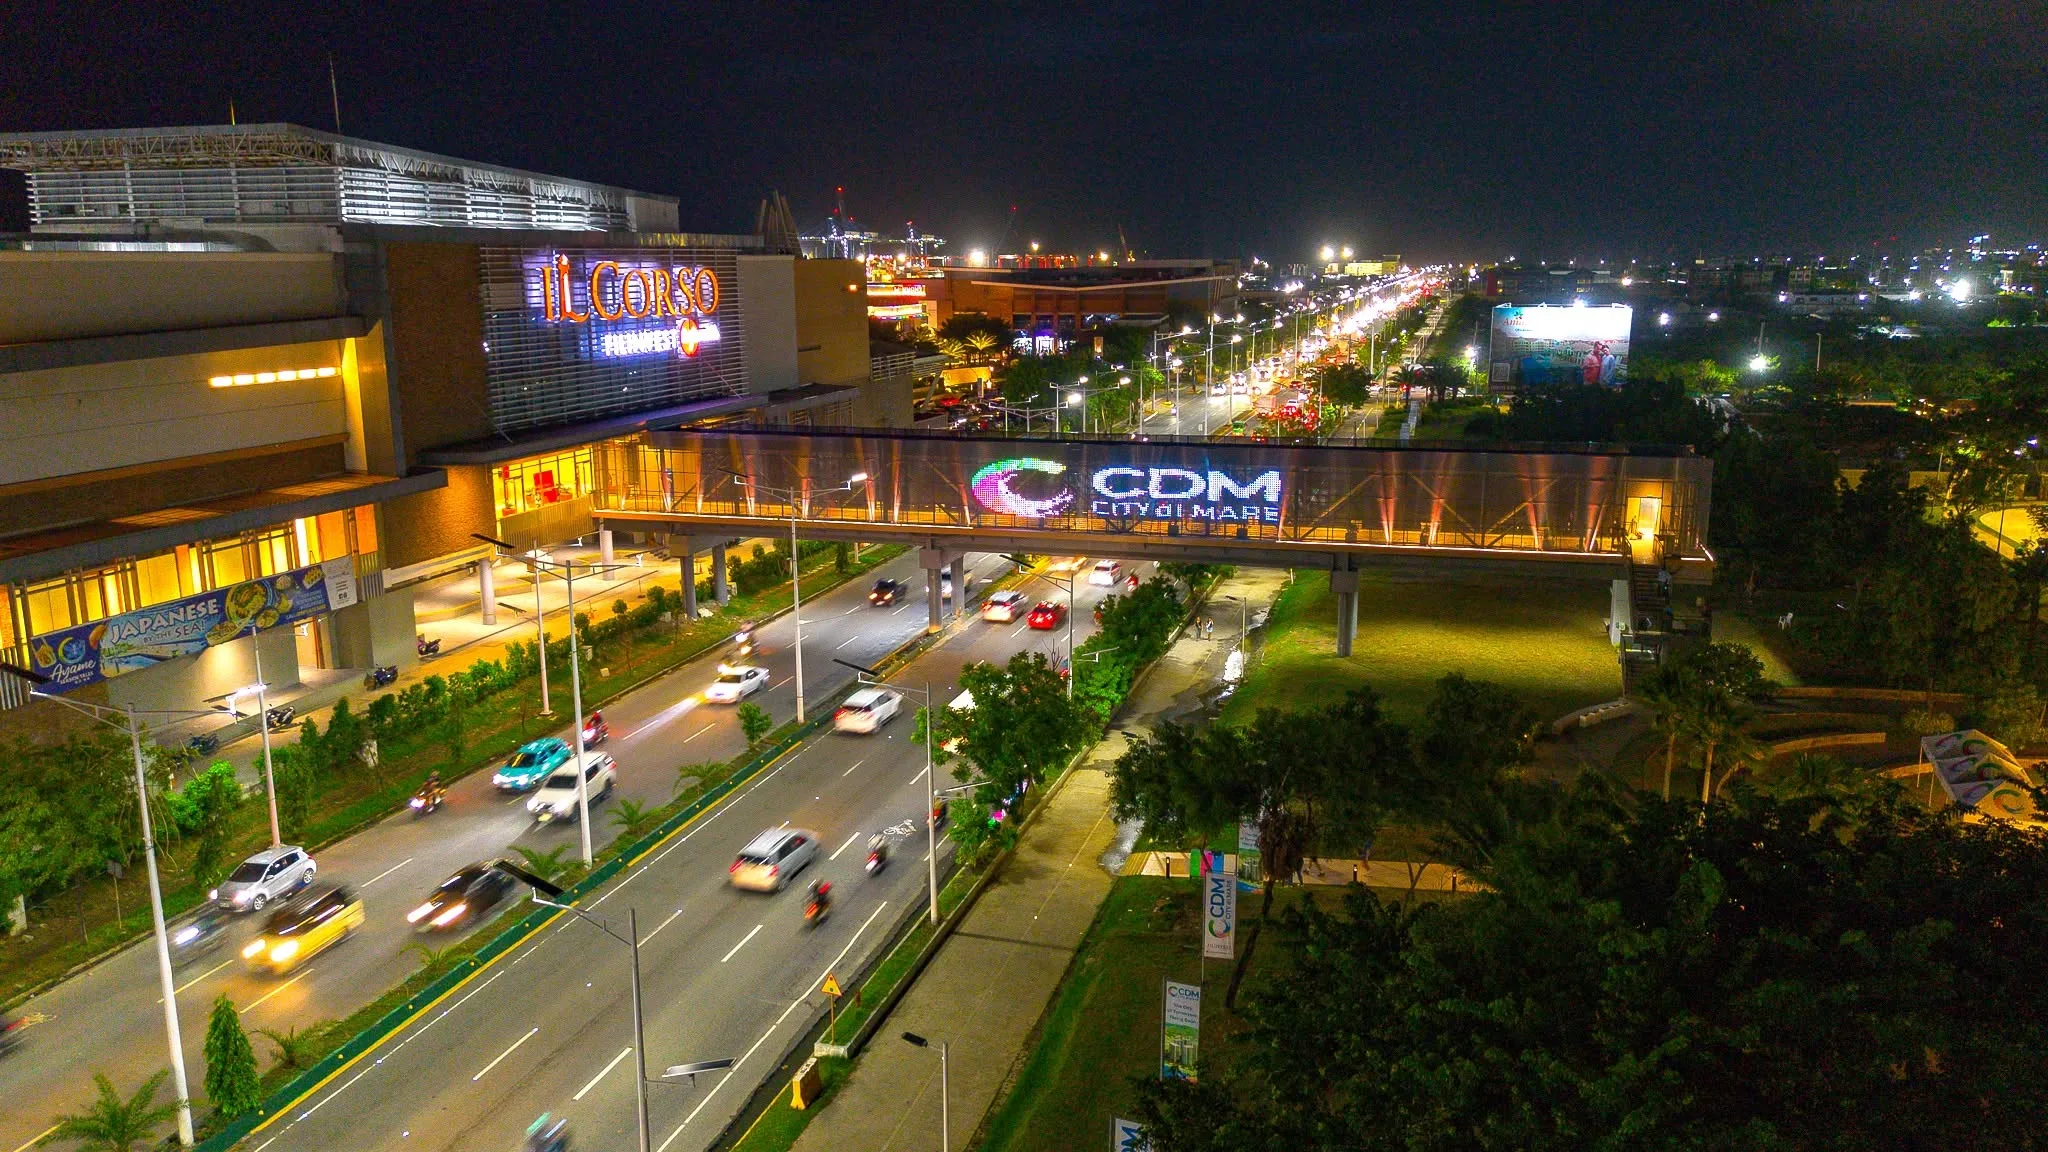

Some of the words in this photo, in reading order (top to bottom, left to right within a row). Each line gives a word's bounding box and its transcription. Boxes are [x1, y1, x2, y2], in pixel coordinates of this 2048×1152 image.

[1092, 467, 1281, 502] CDM
[1091, 500, 1149, 517] CITY
[1192, 504, 1279, 522] MARE
[111, 598, 219, 644] JAPANESE
[51, 659, 97, 683] Ayame
[1209, 877, 1225, 918] CDM
[1178, 987, 1200, 998] CDM
